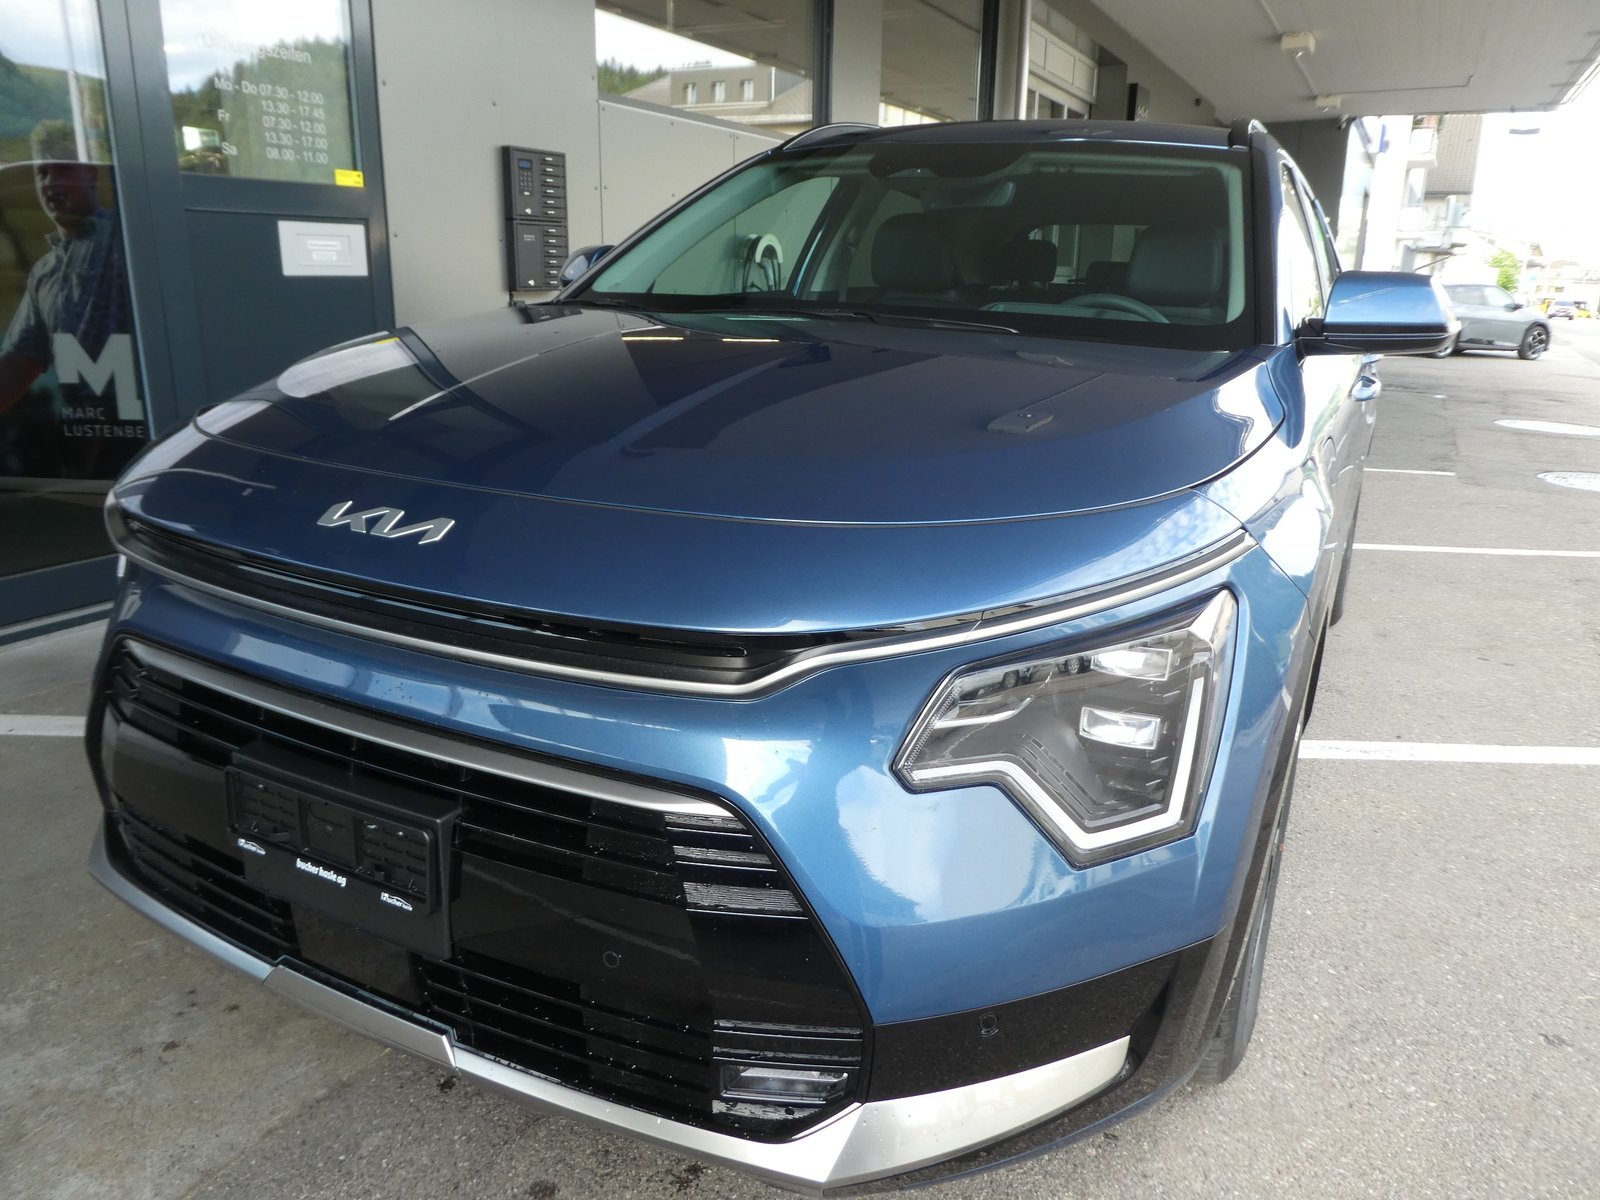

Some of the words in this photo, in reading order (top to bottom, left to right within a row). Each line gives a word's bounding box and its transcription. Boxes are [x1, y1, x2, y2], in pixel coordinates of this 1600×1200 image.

[214, 76, 232, 91] Mo
[241, 80, 257, 95] Do
[258, 83, 289, 99] 07.30
[297, 90, 325, 105] 12.00
[217, 108, 232, 123] Fr
[262, 115, 292, 131] 07.30
[300, 120, 327, 135] 12.00
[261, 100, 290, 115] 13.30
[299, 105, 326, 120] 17.45
[221, 141, 238, 157] Sa
[303, 151, 329, 165] 11.00
[264, 131, 293, 146] 13.30
[302, 135, 328, 150] 17.00
[53, 332, 144, 420] M
[61, 407, 106, 420] MARC
[63, 424, 145, 438] LUSTENBE
[316, 500, 455, 544] KIA
[296, 857, 319, 874] bucher
[319, 866, 338, 882] hasle
[337, 875, 347, 887] ag
